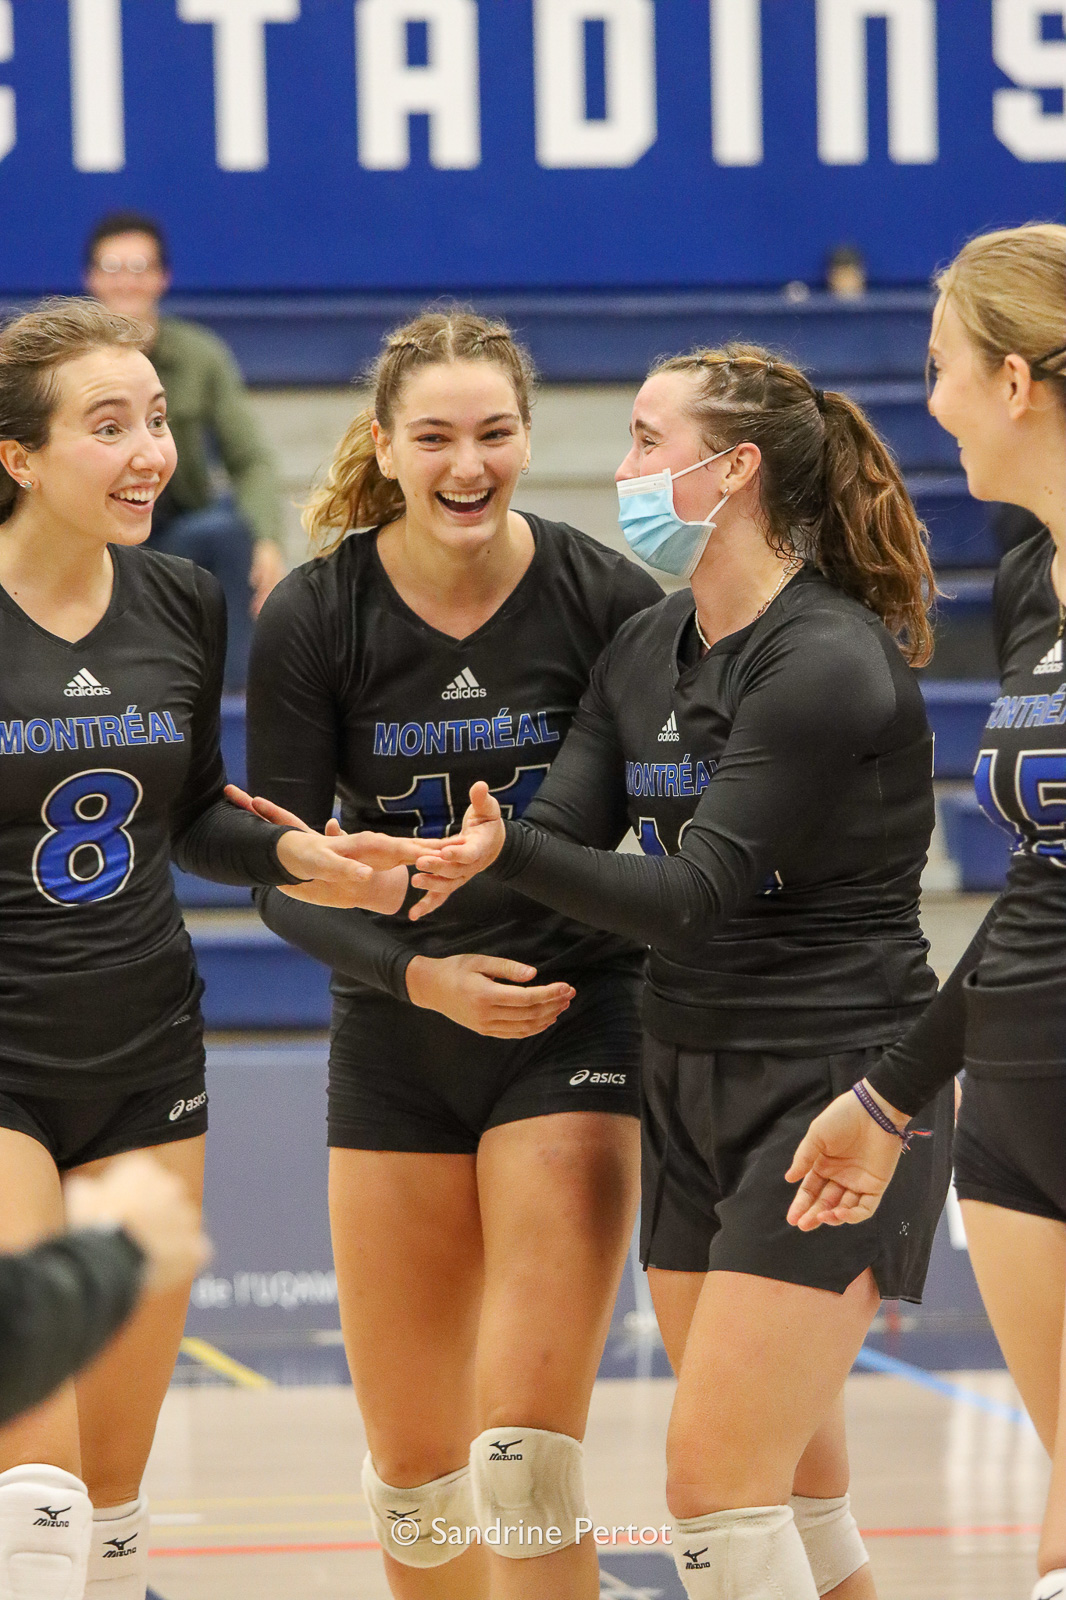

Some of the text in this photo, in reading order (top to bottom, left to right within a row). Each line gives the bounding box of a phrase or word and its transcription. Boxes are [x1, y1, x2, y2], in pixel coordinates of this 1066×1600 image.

[0, 0, 1066, 172] ITADINS
[63, 684, 111, 697] adidas
[442, 686, 487, 700] adidas
[0, 705, 184, 755] MONTRÉAL
[373, 707, 560, 757] MONTRÉAL
[32, 768, 143, 907] 8
[589, 1071, 626, 1086] asics
